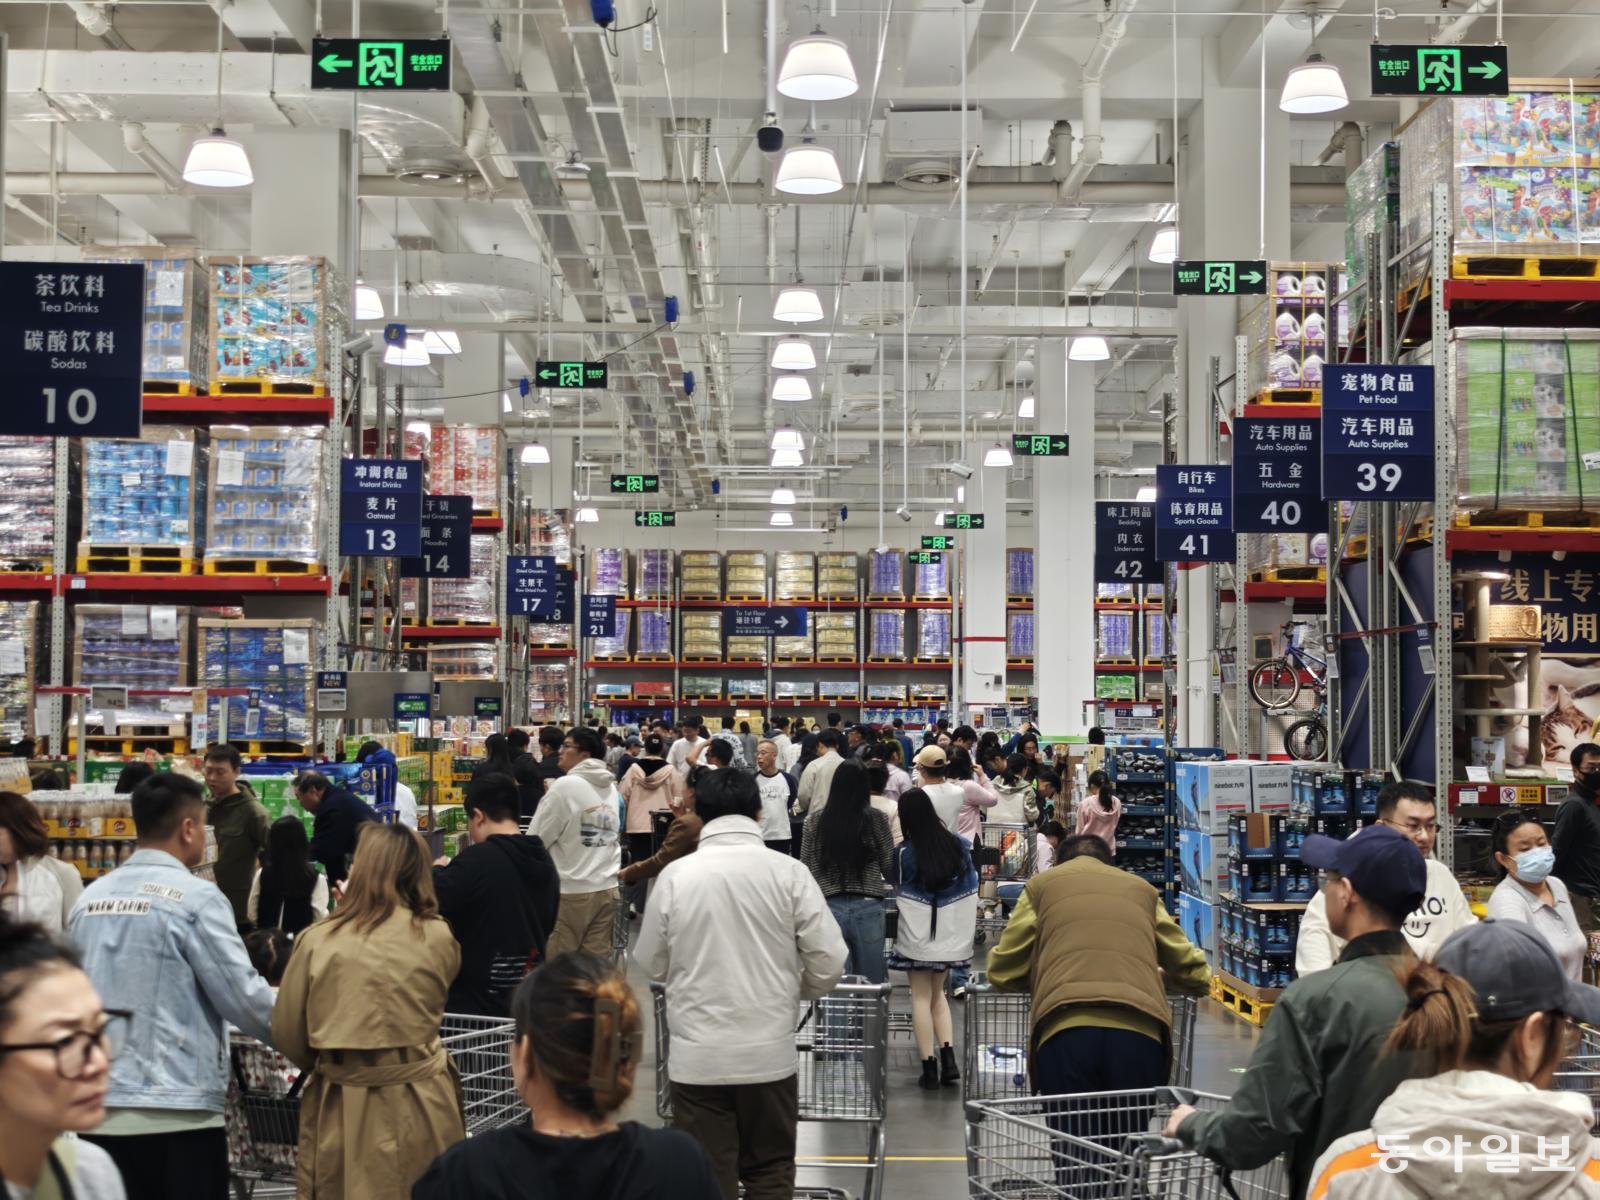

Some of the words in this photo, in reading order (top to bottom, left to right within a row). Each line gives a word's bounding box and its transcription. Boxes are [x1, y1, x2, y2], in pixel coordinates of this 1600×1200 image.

[410, 54, 443, 65] 安全出口
[1378, 60, 1410, 70] 安全出口
[35, 274, 105, 298] 茶饮料
[40, 301, 61, 312] Tea
[65, 302, 99, 313] Drinks
[24, 330, 116, 354] 碳酸饮料
[50, 358, 87, 369] Sodas
[1341, 373, 1414, 392] 宠物食品
[42, 388, 97, 425] 10
[1359, 395, 1373, 404] Pet
[1375, 395, 1398, 404] Food
[1249, 424, 1312, 441] 汽车用品
[1341, 417, 1414, 436] 汽车用品
[1255, 443, 1274, 451] Auto
[1275, 443, 1307, 453] Supplies
[1348, 439, 1369, 448] Auto
[1371, 439, 1408, 450] Supplies
[354, 465, 408, 480] 冲调食品
[1177, 471, 1216, 485] 自行车
[1356, 463, 1402, 492] 39
[382, 481, 402, 489] Drinks
[1261, 480, 1301, 489] Hardware
[366, 497, 398, 511] 麦片
[1170, 502, 1223, 516] 体育用品
[366, 512, 396, 520] Oatmeal
[1107, 506, 1152, 518] 床上用品
[1260, 500, 1301, 525] 40
[1174, 517, 1195, 526] Sports
[1196, 517, 1219, 525] Goods
[365, 529, 397, 551] 13
[1179, 534, 1208, 555] 41
[424, 555, 450, 573] 14
[1114, 560, 1143, 578] 42
[1500, 569, 1600, 602] 线上专
[521, 598, 542, 612] 17
[590, 625, 604, 635] 21
